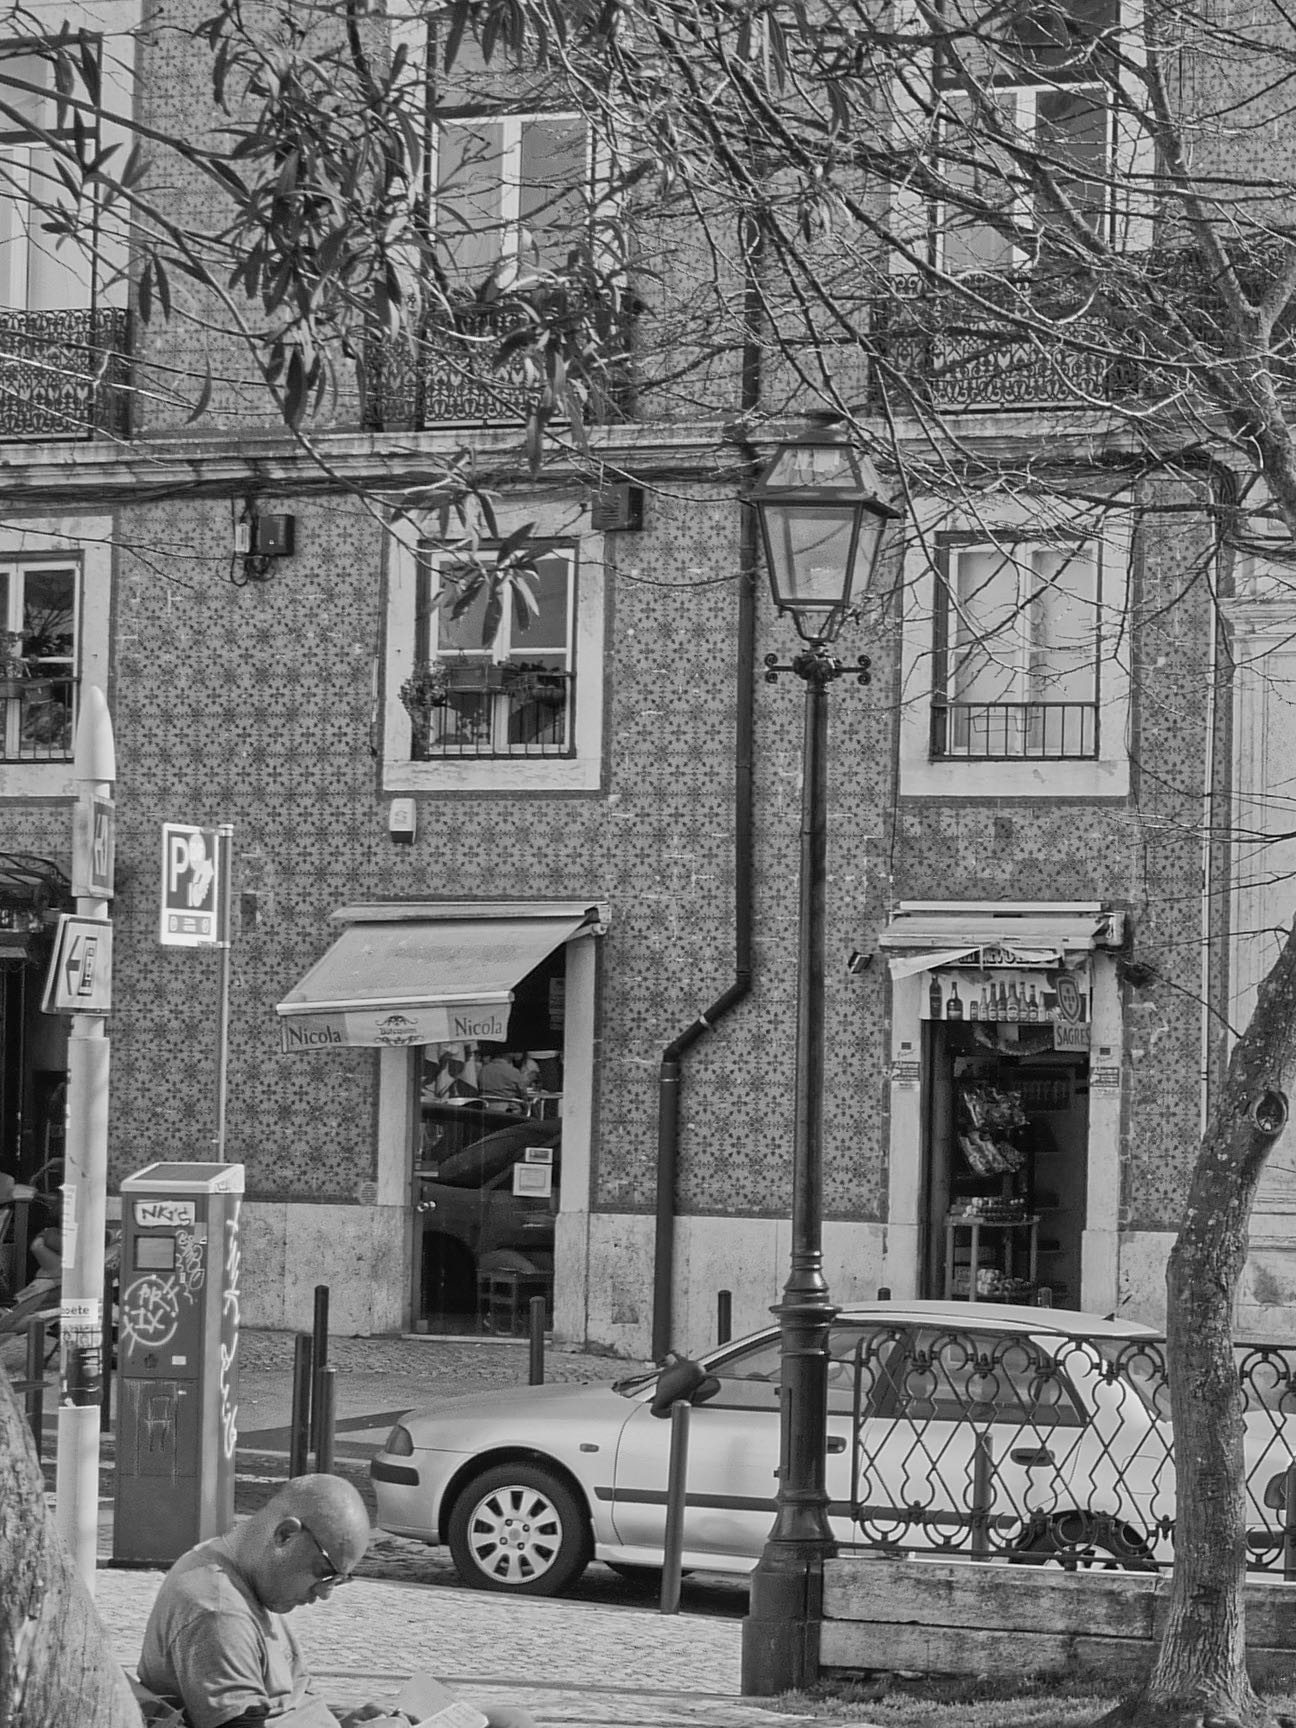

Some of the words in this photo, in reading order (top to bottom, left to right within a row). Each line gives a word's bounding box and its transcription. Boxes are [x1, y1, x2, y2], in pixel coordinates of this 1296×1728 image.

[170, 836, 189, 892] P
[288, 1024, 343, 1046] Nicola
[454, 1016, 503, 1037] Nicola
[1056, 1024, 1091, 1048] SAGRES
